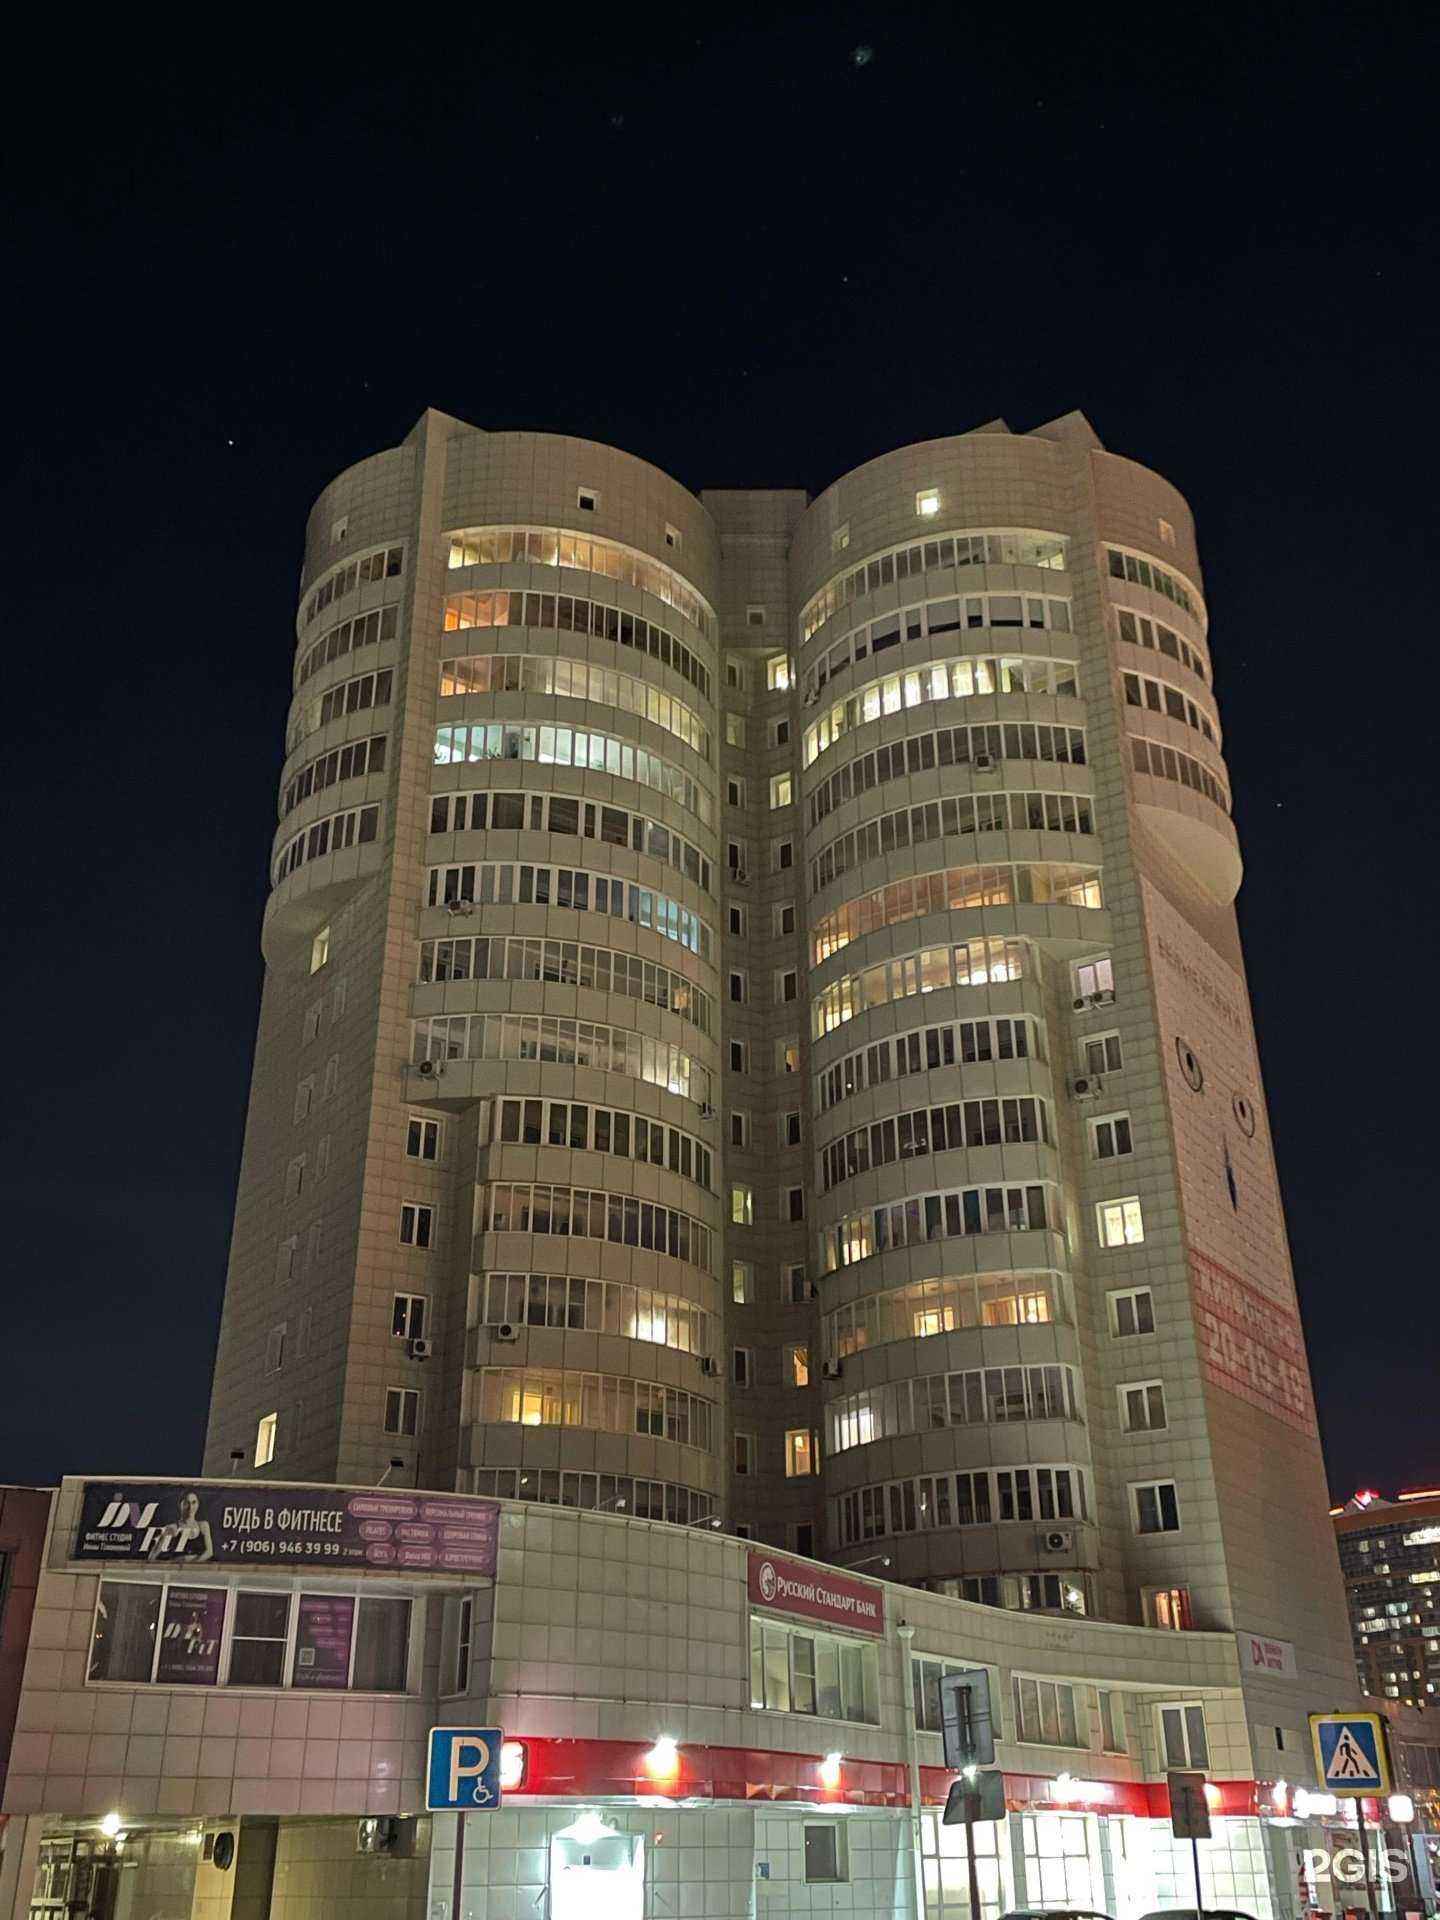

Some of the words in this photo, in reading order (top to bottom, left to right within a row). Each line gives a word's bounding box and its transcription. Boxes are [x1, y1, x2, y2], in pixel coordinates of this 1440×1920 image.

[222, 1506, 260, 1533] БУДЬ
[263, 1508, 274, 1530] В
[277, 1508, 343, 1533] ФИТНЕСЕ
[221, 1540, 238, 1552] +7
[240, 1540, 275, 1554] (906)
[279, 1541, 302, 1554] 946
[304, 1542, 321, 1554] 39
[323, 1543, 340, 1555] 99
[777, 1576, 816, 1602] РУССКИЙ
[816, 1588, 856, 1612] СТАНДАРТ
[856, 1601, 876, 1617] БАНК
[449, 1736, 490, 1802] P
